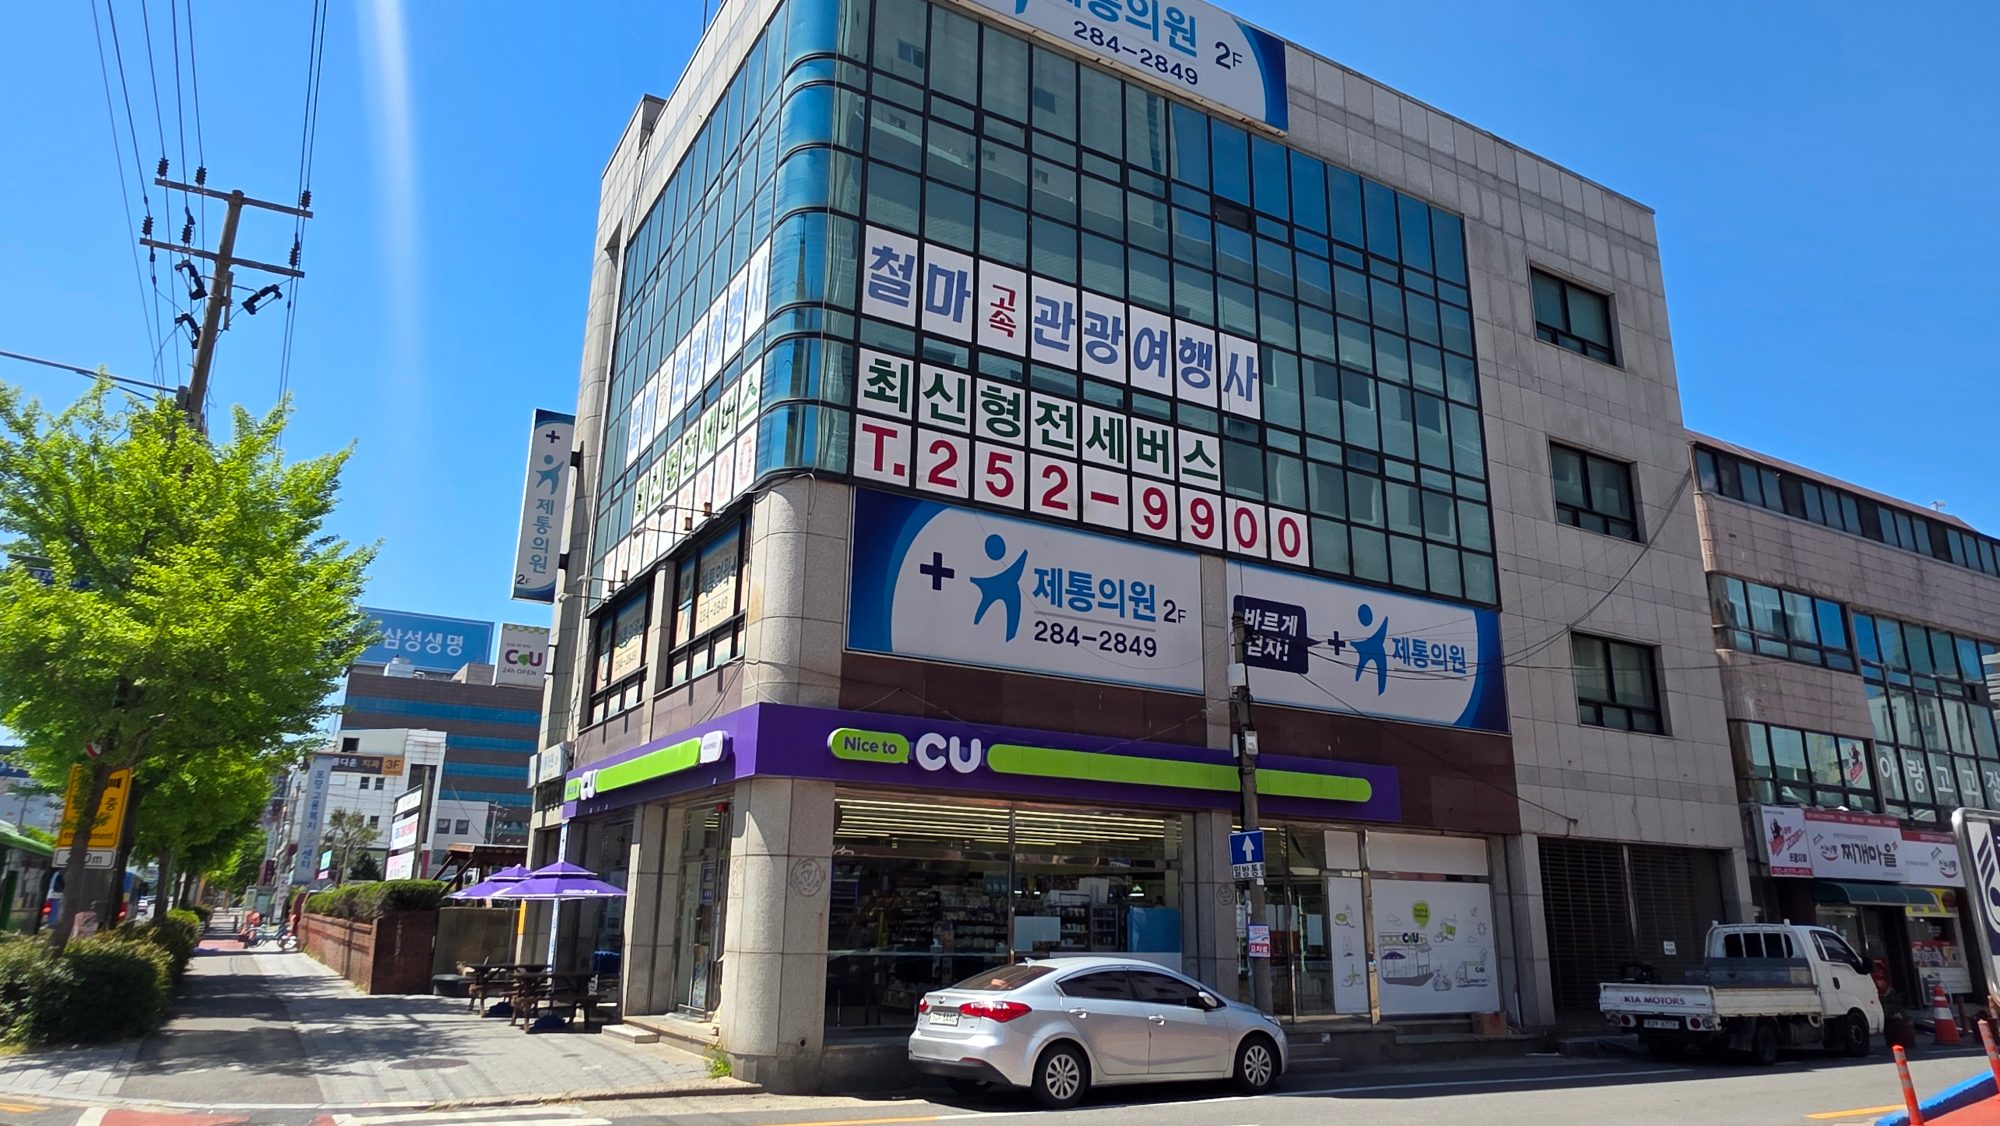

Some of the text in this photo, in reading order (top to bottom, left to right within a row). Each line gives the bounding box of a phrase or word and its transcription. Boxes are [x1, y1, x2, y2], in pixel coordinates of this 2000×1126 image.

[1073, 20, 1199, 86] 284-2849
[1214, 41, 1243, 70] 2F
[863, 356, 1220, 481] 최신형전세버스
[529, 498, 555, 574] 제통의원
[1032, 567, 1187, 624] 제통의원 2F
[1244, 608, 1298, 637] 바르게
[381, 628, 464, 657] 삼성생명
[1033, 620, 1158, 658] 284-2849
[505, 649, 543, 667] CU
[1391, 636, 1468, 675] 제통의원
[516, 668, 537, 676] OPEN
[385, 759, 401, 769] 3F
[844, 732, 982, 774] Nice to CU
[1841, 842, 1898, 868] 찌개마을
[1624, 996, 1687, 1006] KIA MOTORS
